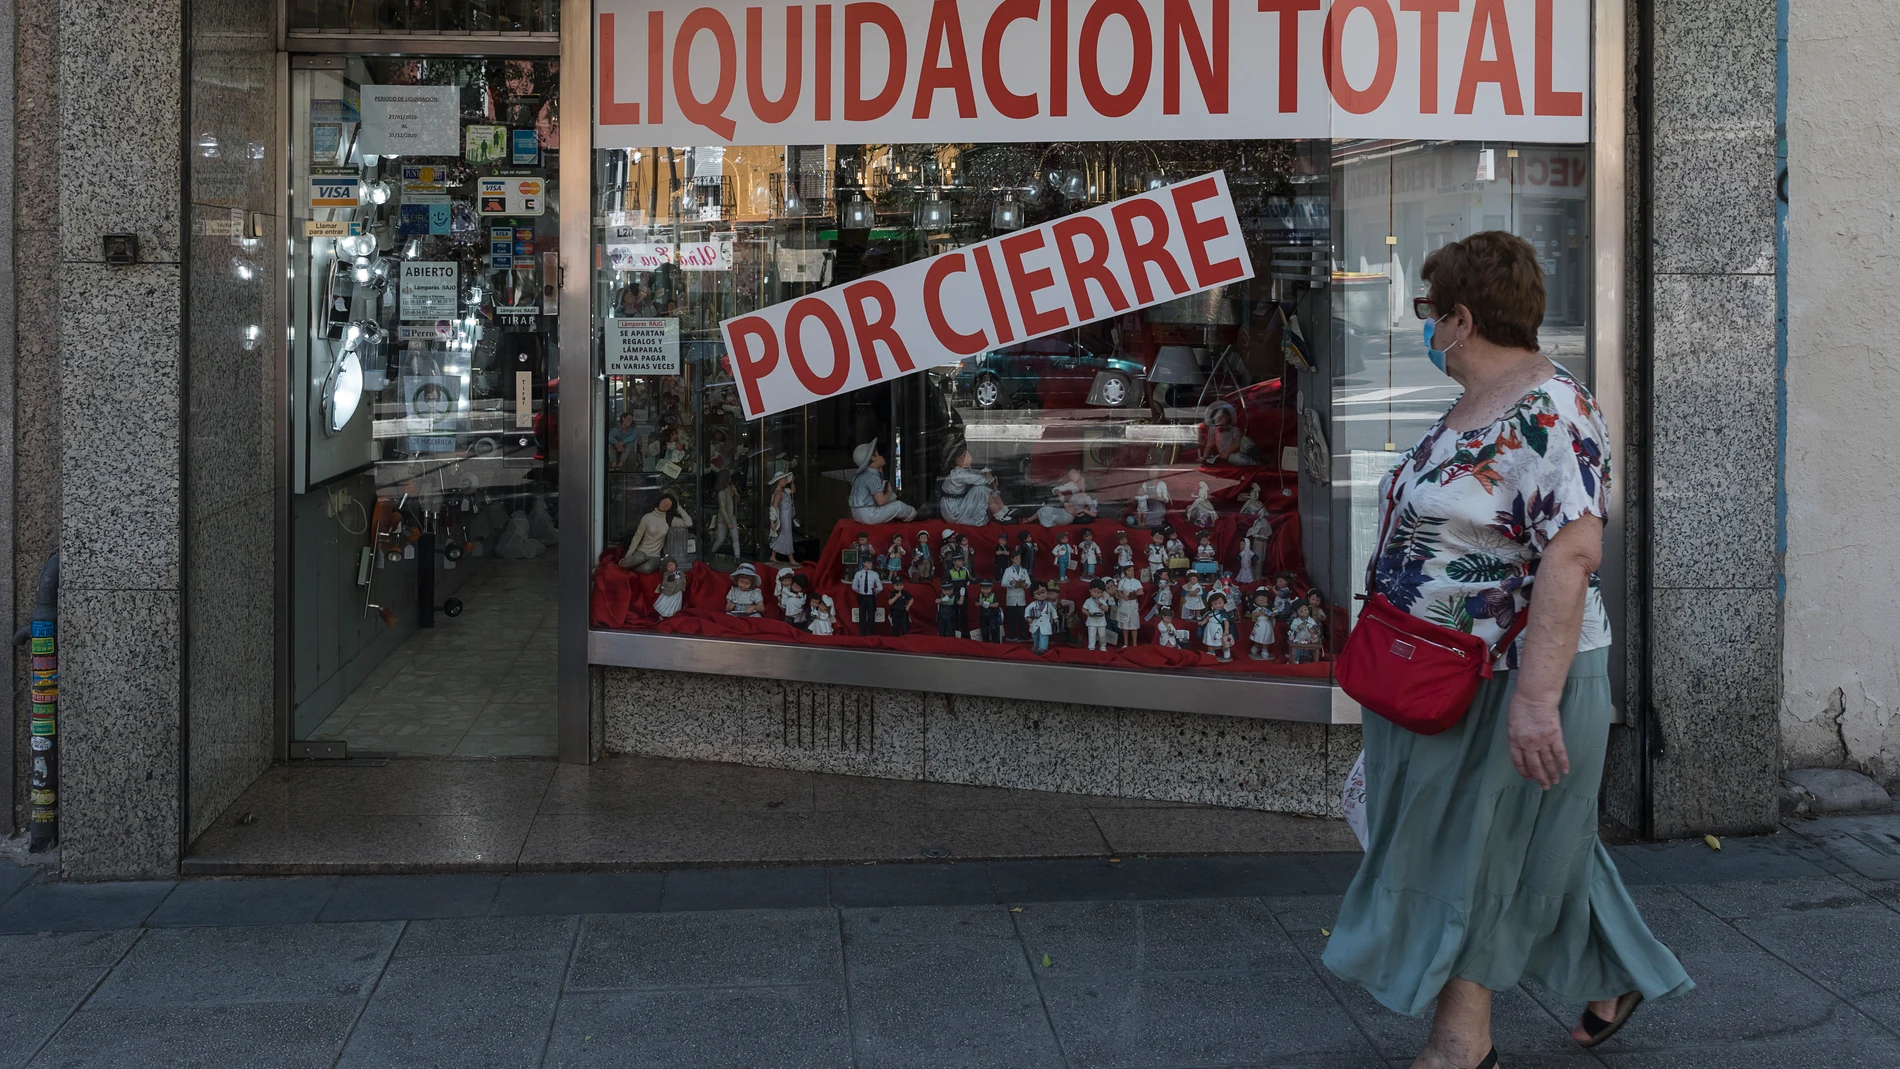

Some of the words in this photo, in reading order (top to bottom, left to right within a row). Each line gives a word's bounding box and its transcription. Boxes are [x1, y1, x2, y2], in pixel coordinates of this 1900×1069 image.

[1258, 0, 1582, 116] TOTAL
[319, 187, 350, 198] VISA
[406, 267, 453, 276] ABIERTO
[727, 279, 914, 415] POR
[923, 177, 1244, 355] CIERRE
[501, 316, 535, 324] TIRAR
